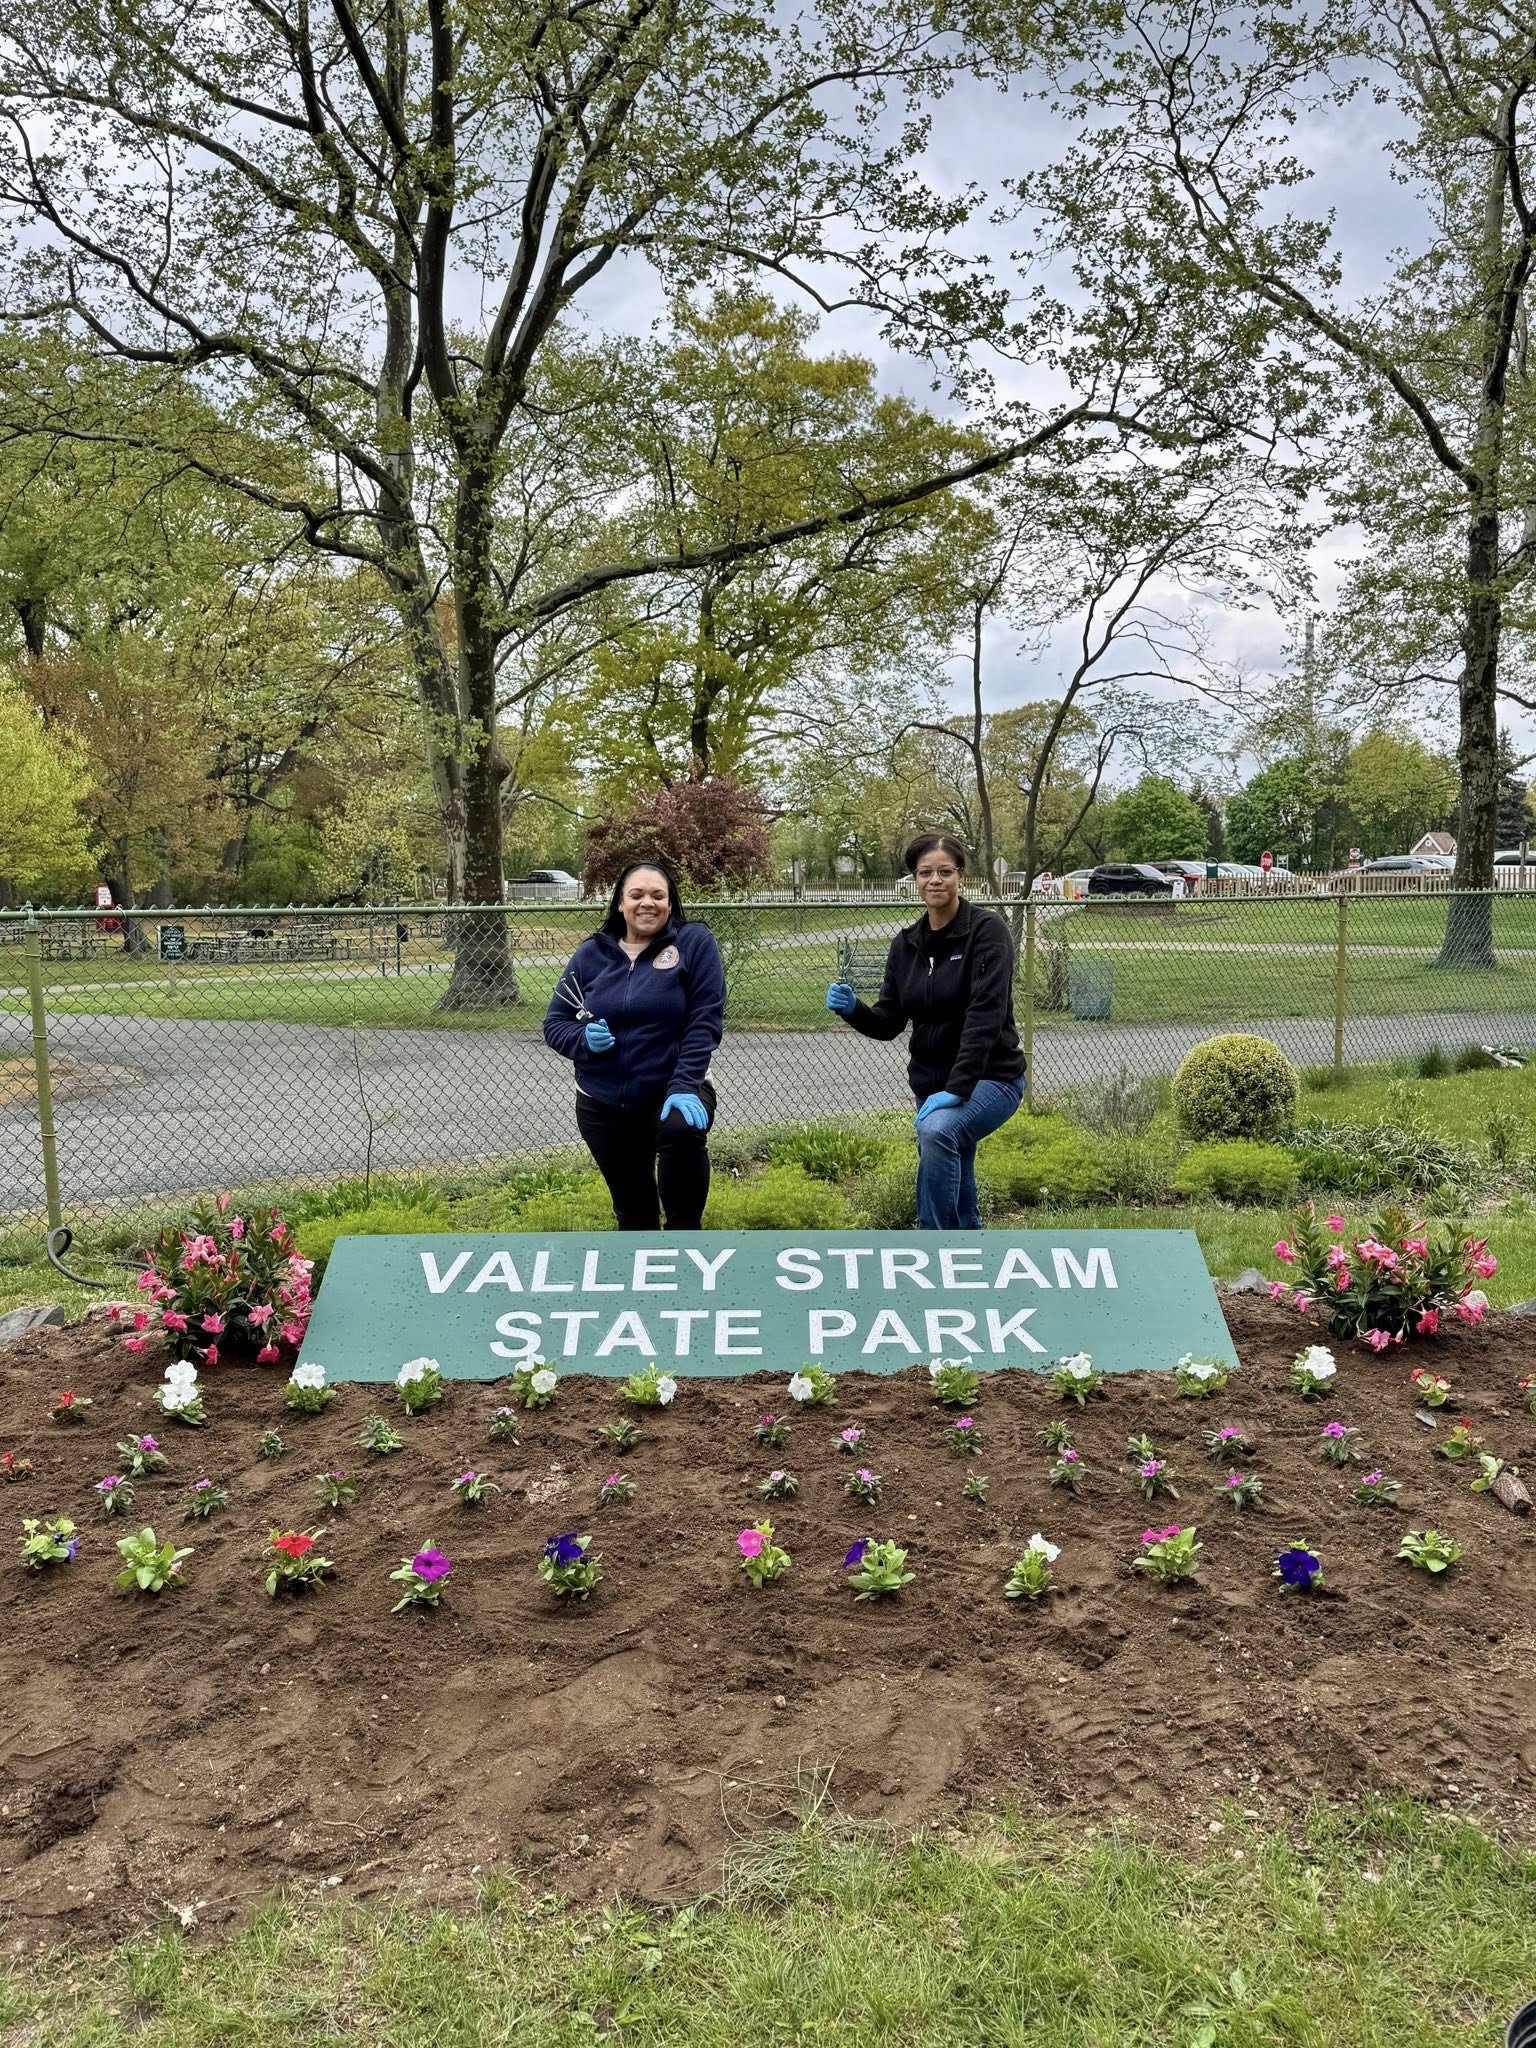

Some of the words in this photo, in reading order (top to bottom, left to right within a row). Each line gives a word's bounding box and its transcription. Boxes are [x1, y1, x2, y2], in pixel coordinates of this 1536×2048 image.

[421, 1248, 736, 1293] VALLEY
[776, 1246, 1119, 1291] STREAM
[489, 1309, 763, 1359] STATE
[808, 1308, 1049, 1355] PARK
